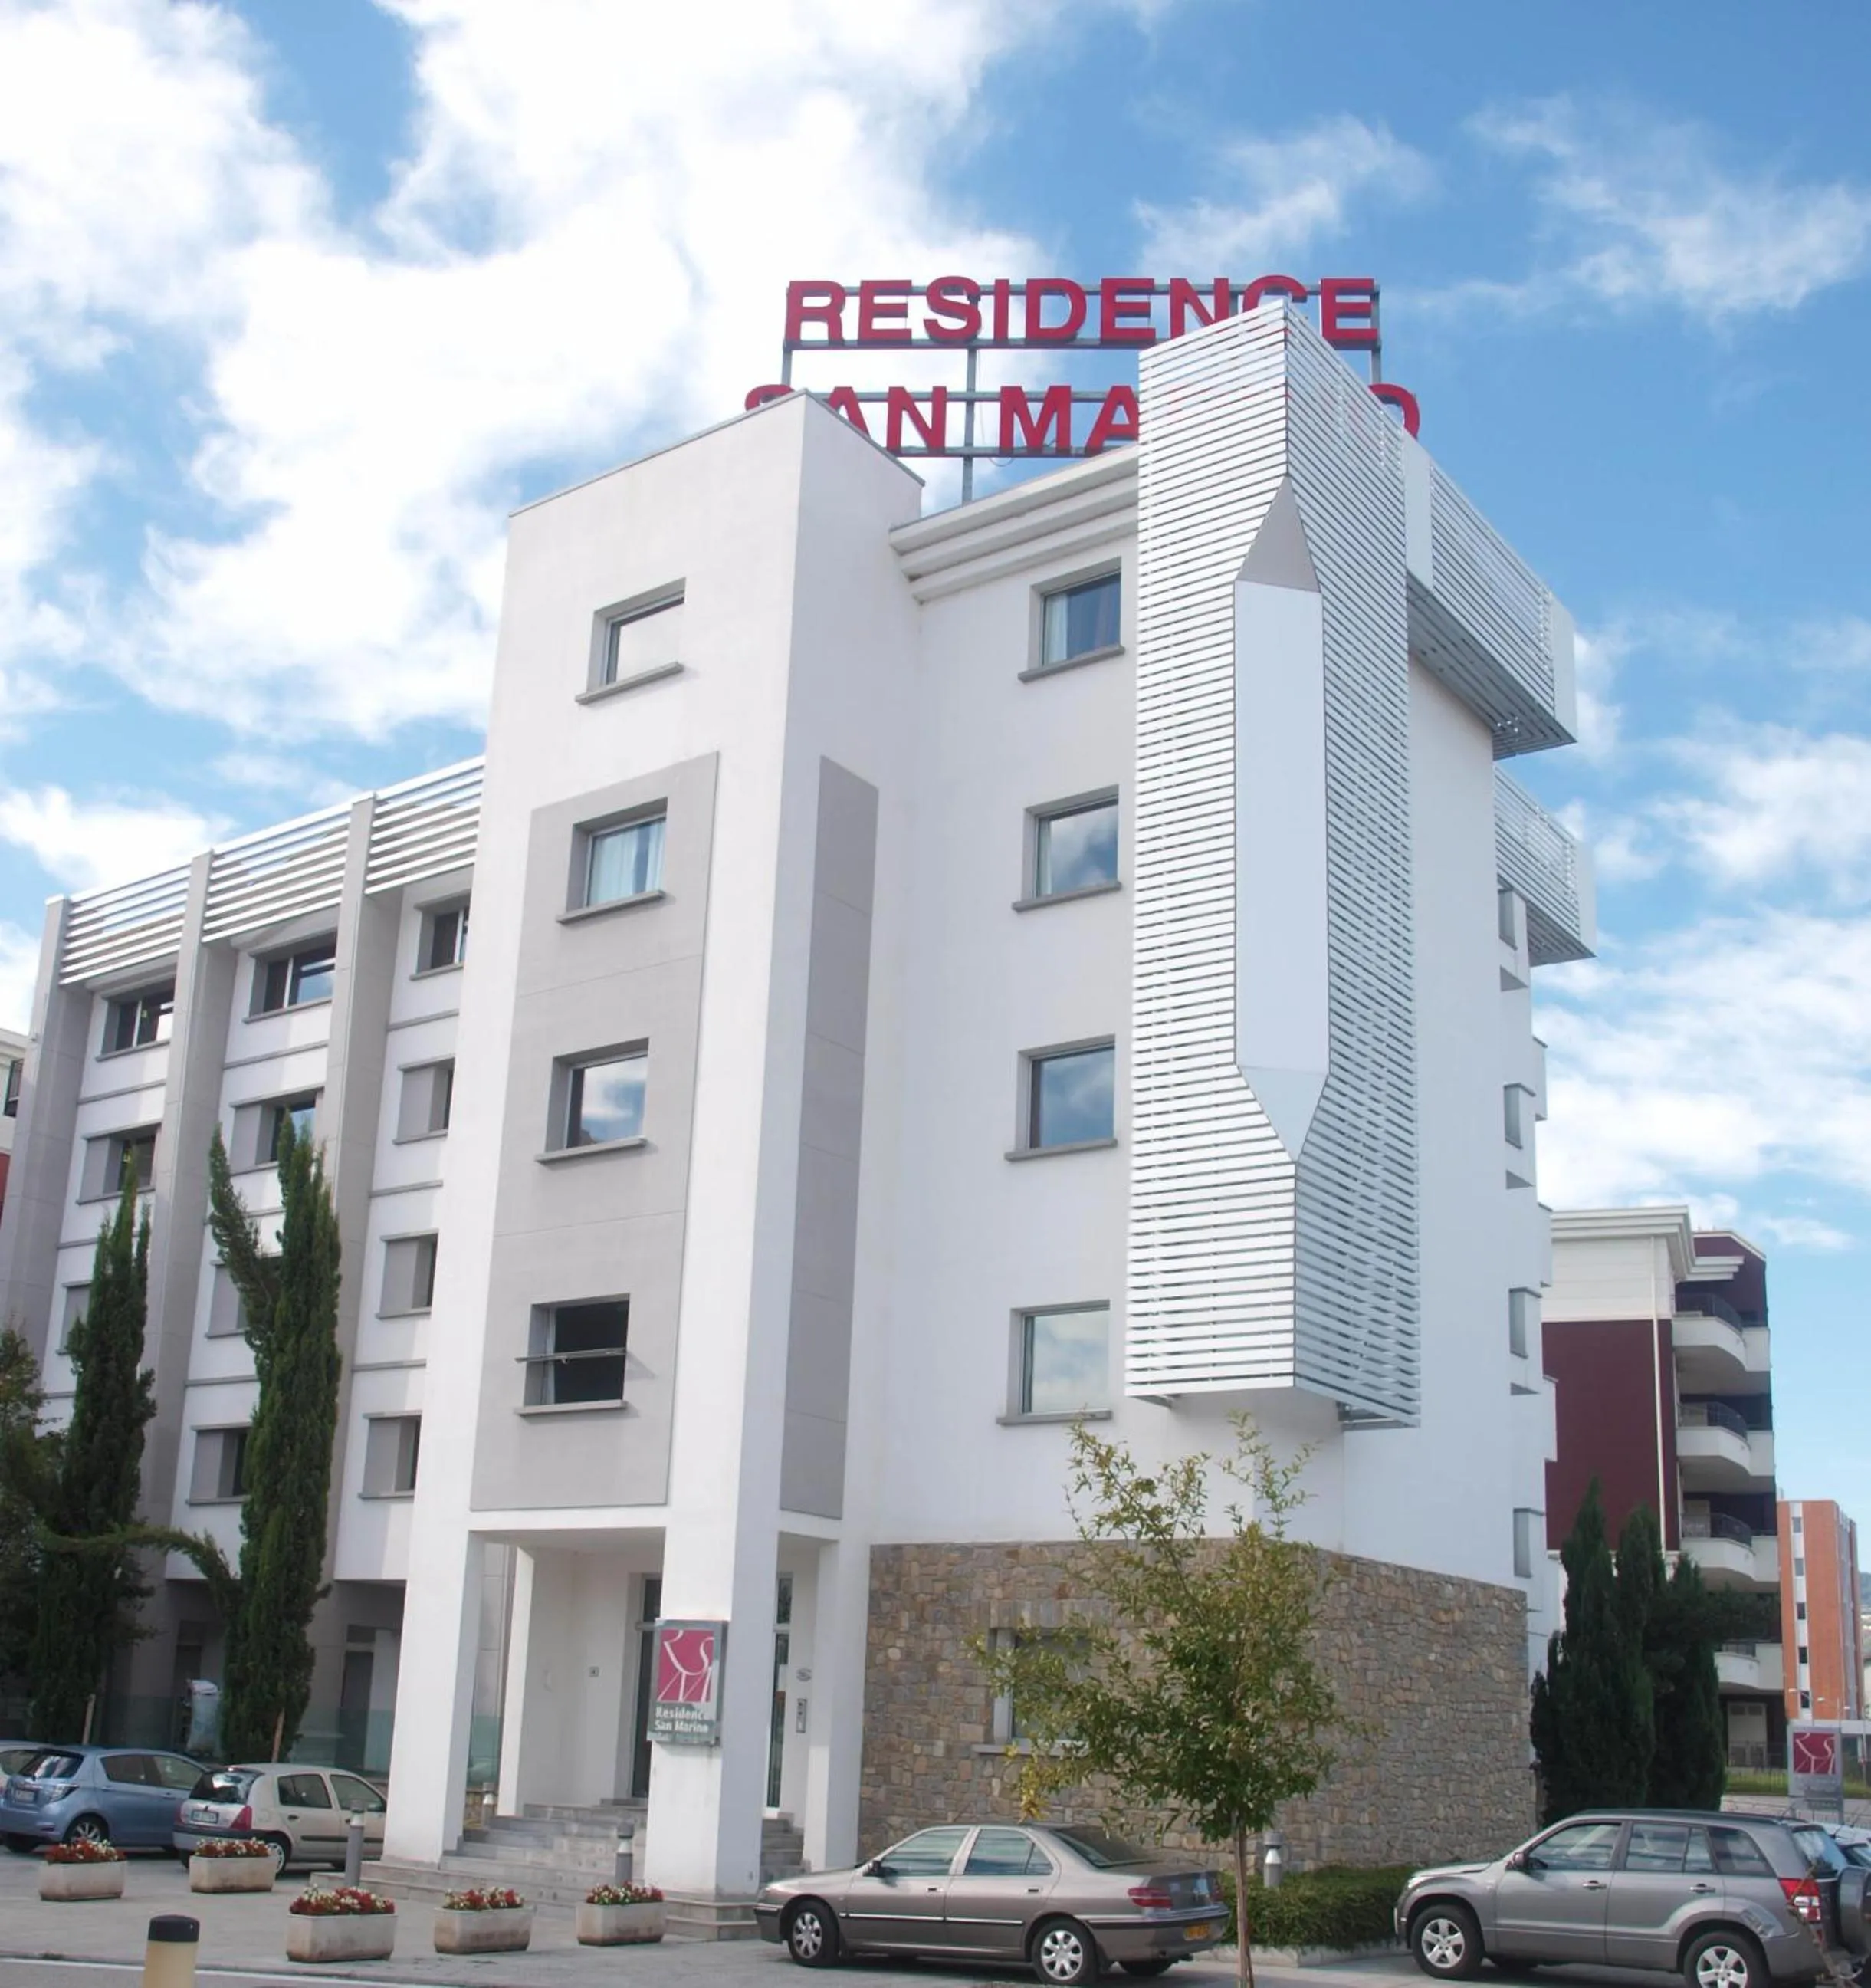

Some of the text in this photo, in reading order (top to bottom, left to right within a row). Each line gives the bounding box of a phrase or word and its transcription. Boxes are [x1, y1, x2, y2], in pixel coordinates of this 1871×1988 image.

[655, 1706, 711, 1721] Residenc
[654, 1719, 710, 1733] San Marino
